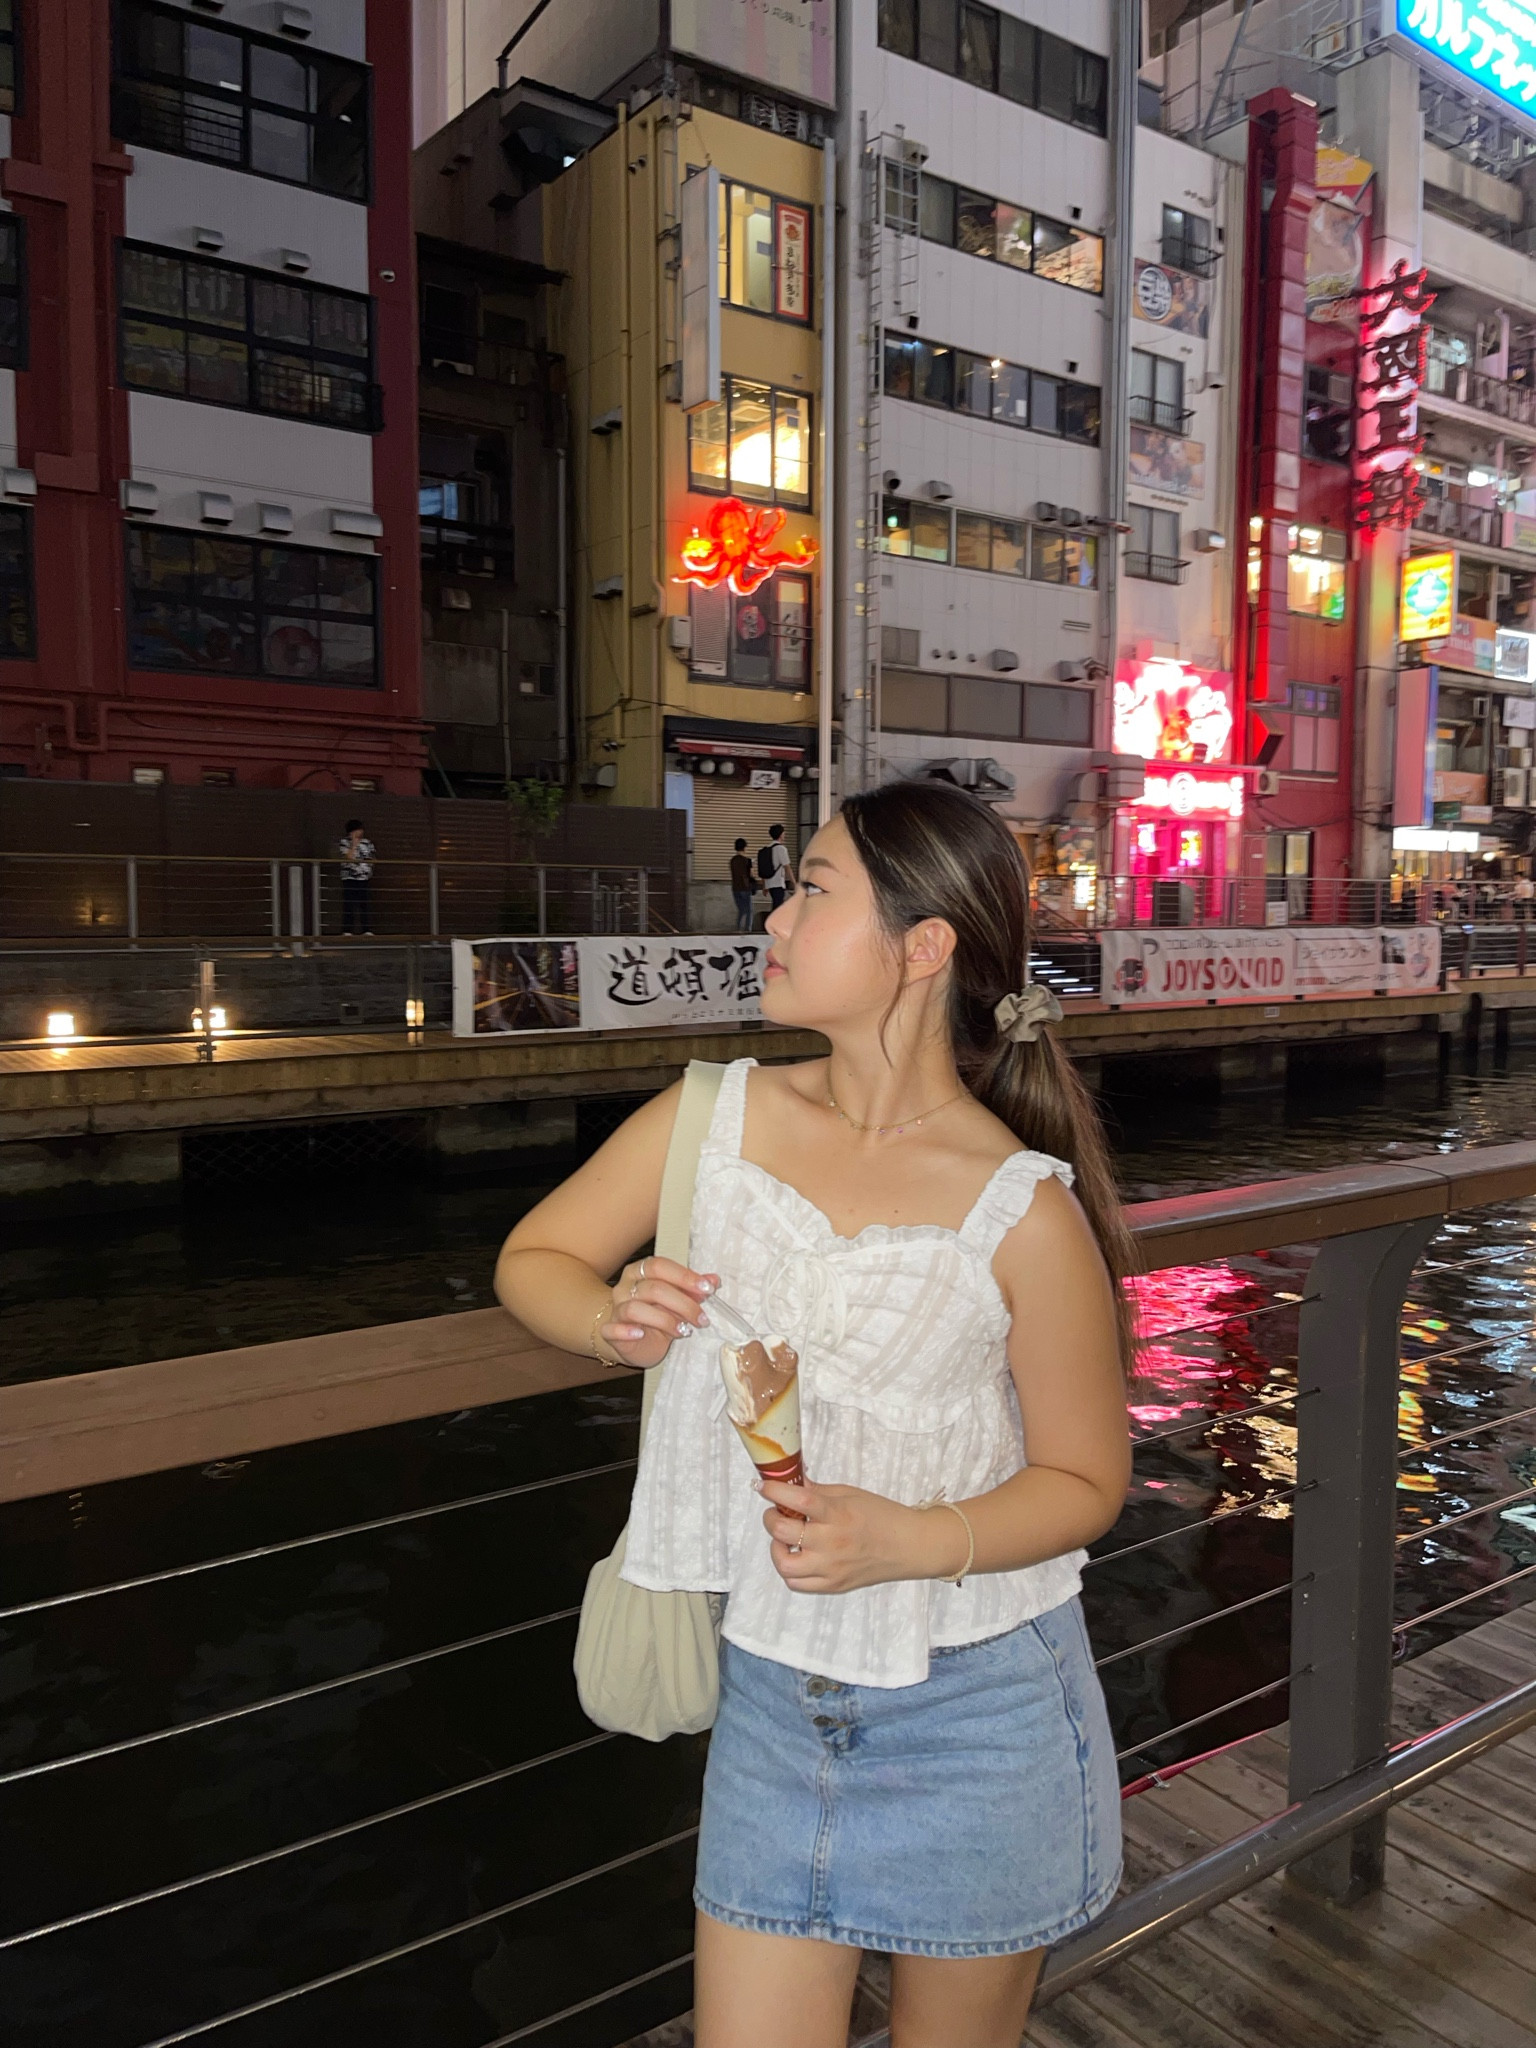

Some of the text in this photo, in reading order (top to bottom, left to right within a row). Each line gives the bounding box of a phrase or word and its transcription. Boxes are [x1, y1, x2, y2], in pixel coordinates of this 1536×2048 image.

[607, 944, 761, 1006] 道頓堀
[1161, 956, 1285, 992] JOYSOUND
